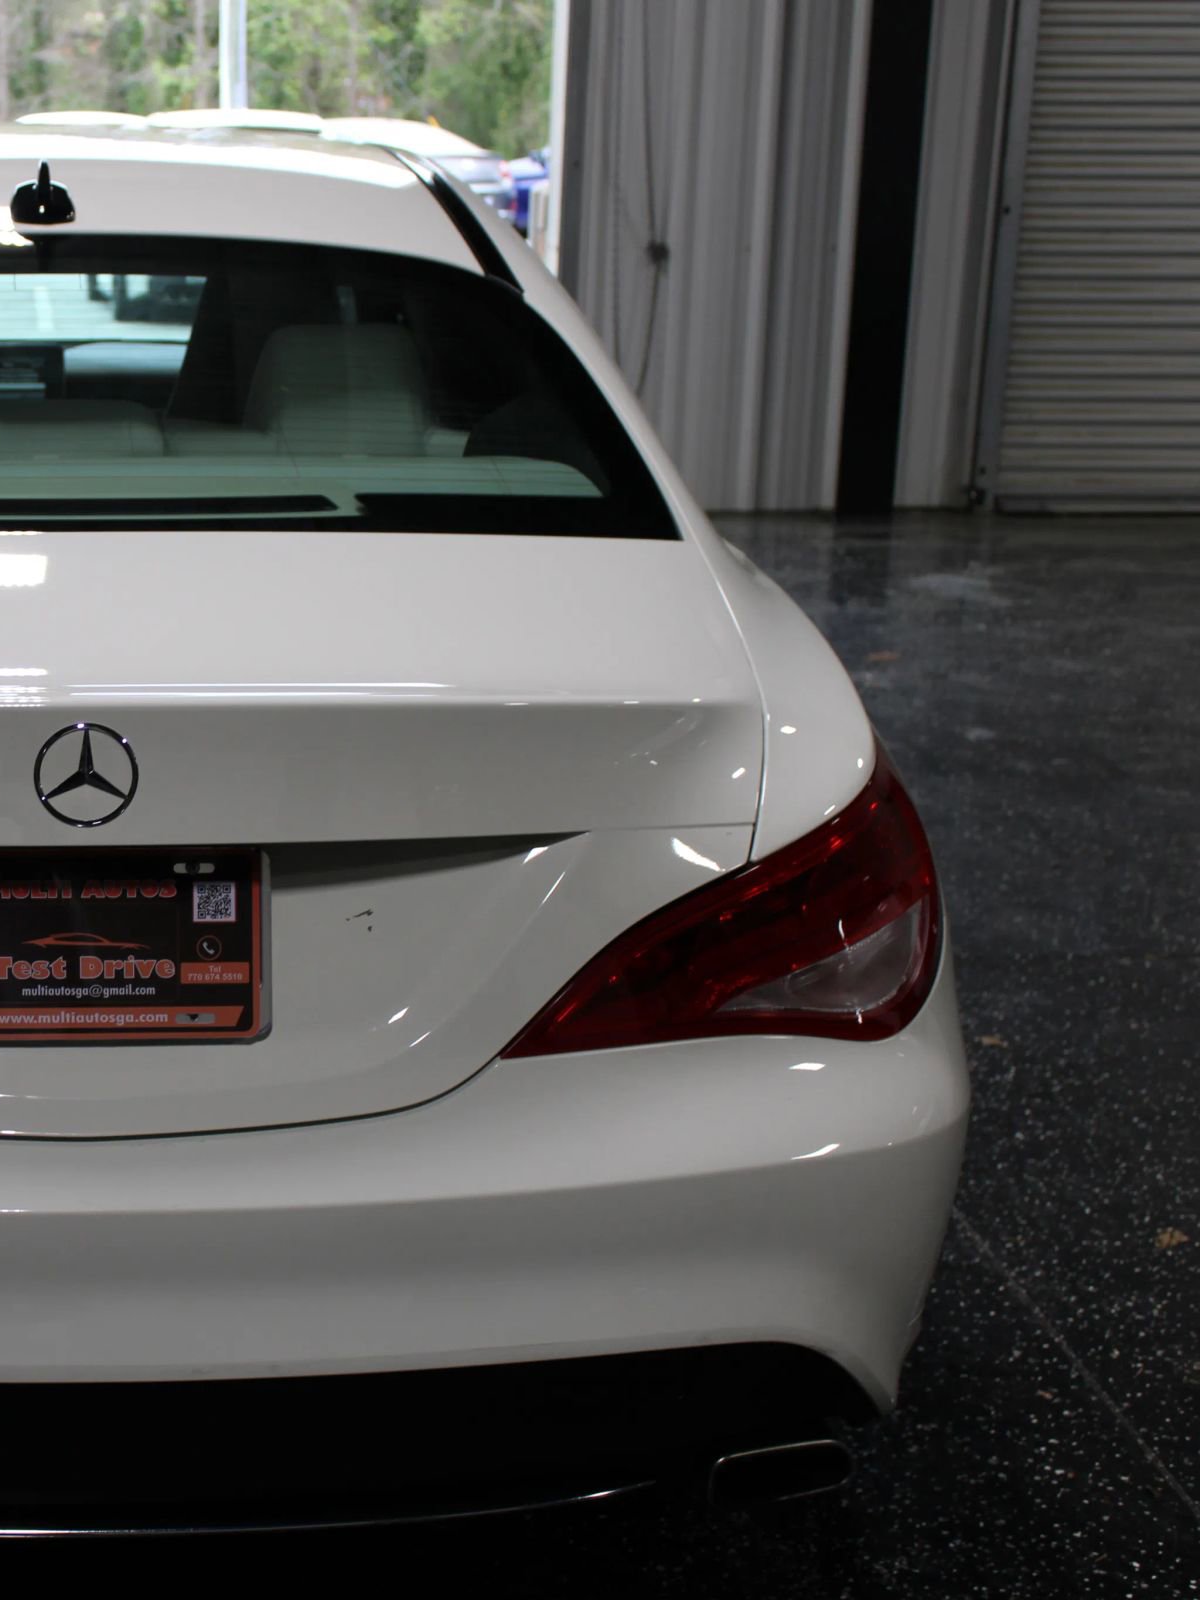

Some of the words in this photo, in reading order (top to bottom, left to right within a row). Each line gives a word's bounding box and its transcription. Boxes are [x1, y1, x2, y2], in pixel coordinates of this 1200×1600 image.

[80, 879, 179, 899] AUTOS
[79, 955, 176, 979] Drive
[208, 965, 222, 973] Tel
[187, 973, 203, 981] 770
[21, 984, 156, 998] multiautosga@gmail.com
